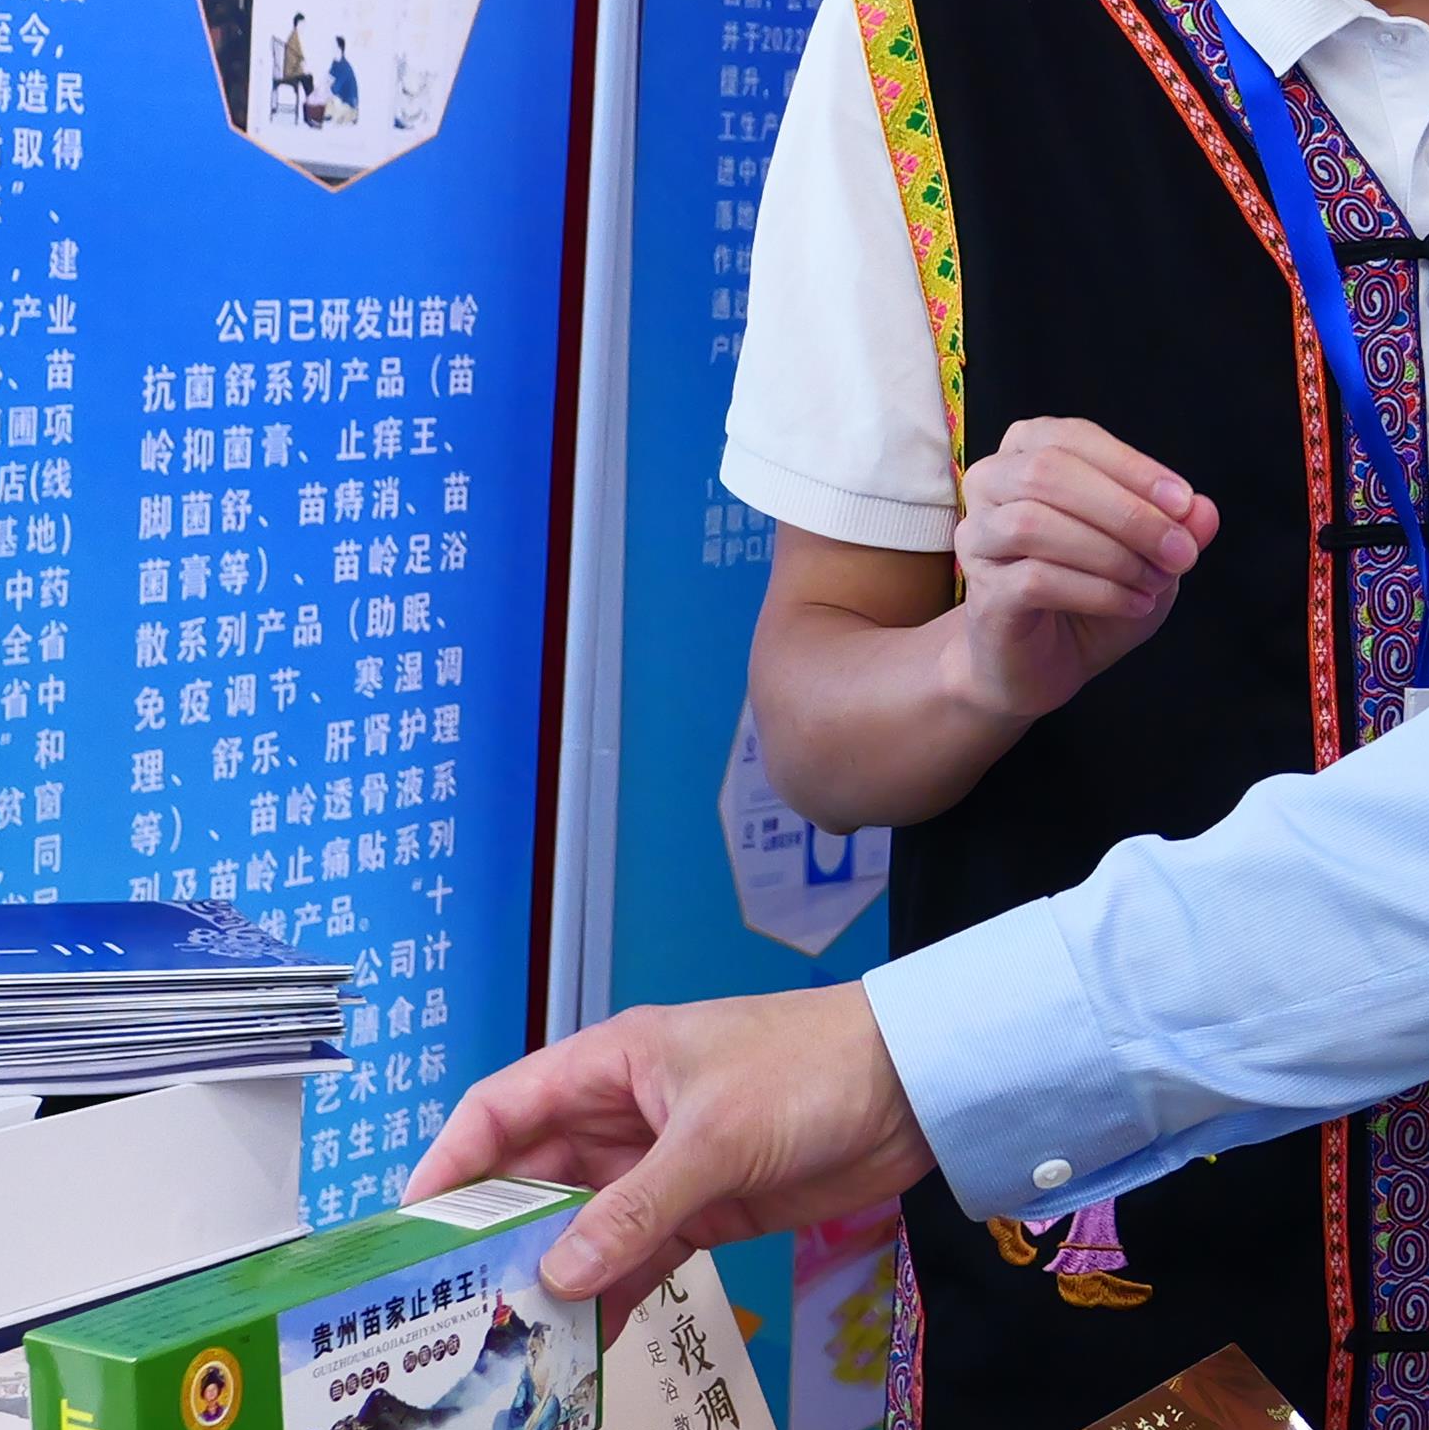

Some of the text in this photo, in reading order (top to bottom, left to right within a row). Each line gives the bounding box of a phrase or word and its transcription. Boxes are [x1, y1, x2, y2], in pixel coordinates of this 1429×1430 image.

[216, 292, 478, 344] 公司已研发出苗岭
[133, 646, 464, 732] 免疫调节、寒湿调
[128, 816, 456, 903] 列及苗岭止痛贴系列
[355, 934, 452, 990] 公司计
[332, 986, 449, 1049] 膳食品
[311, 1270, 475, 1359] 贵州苗家止痒王
